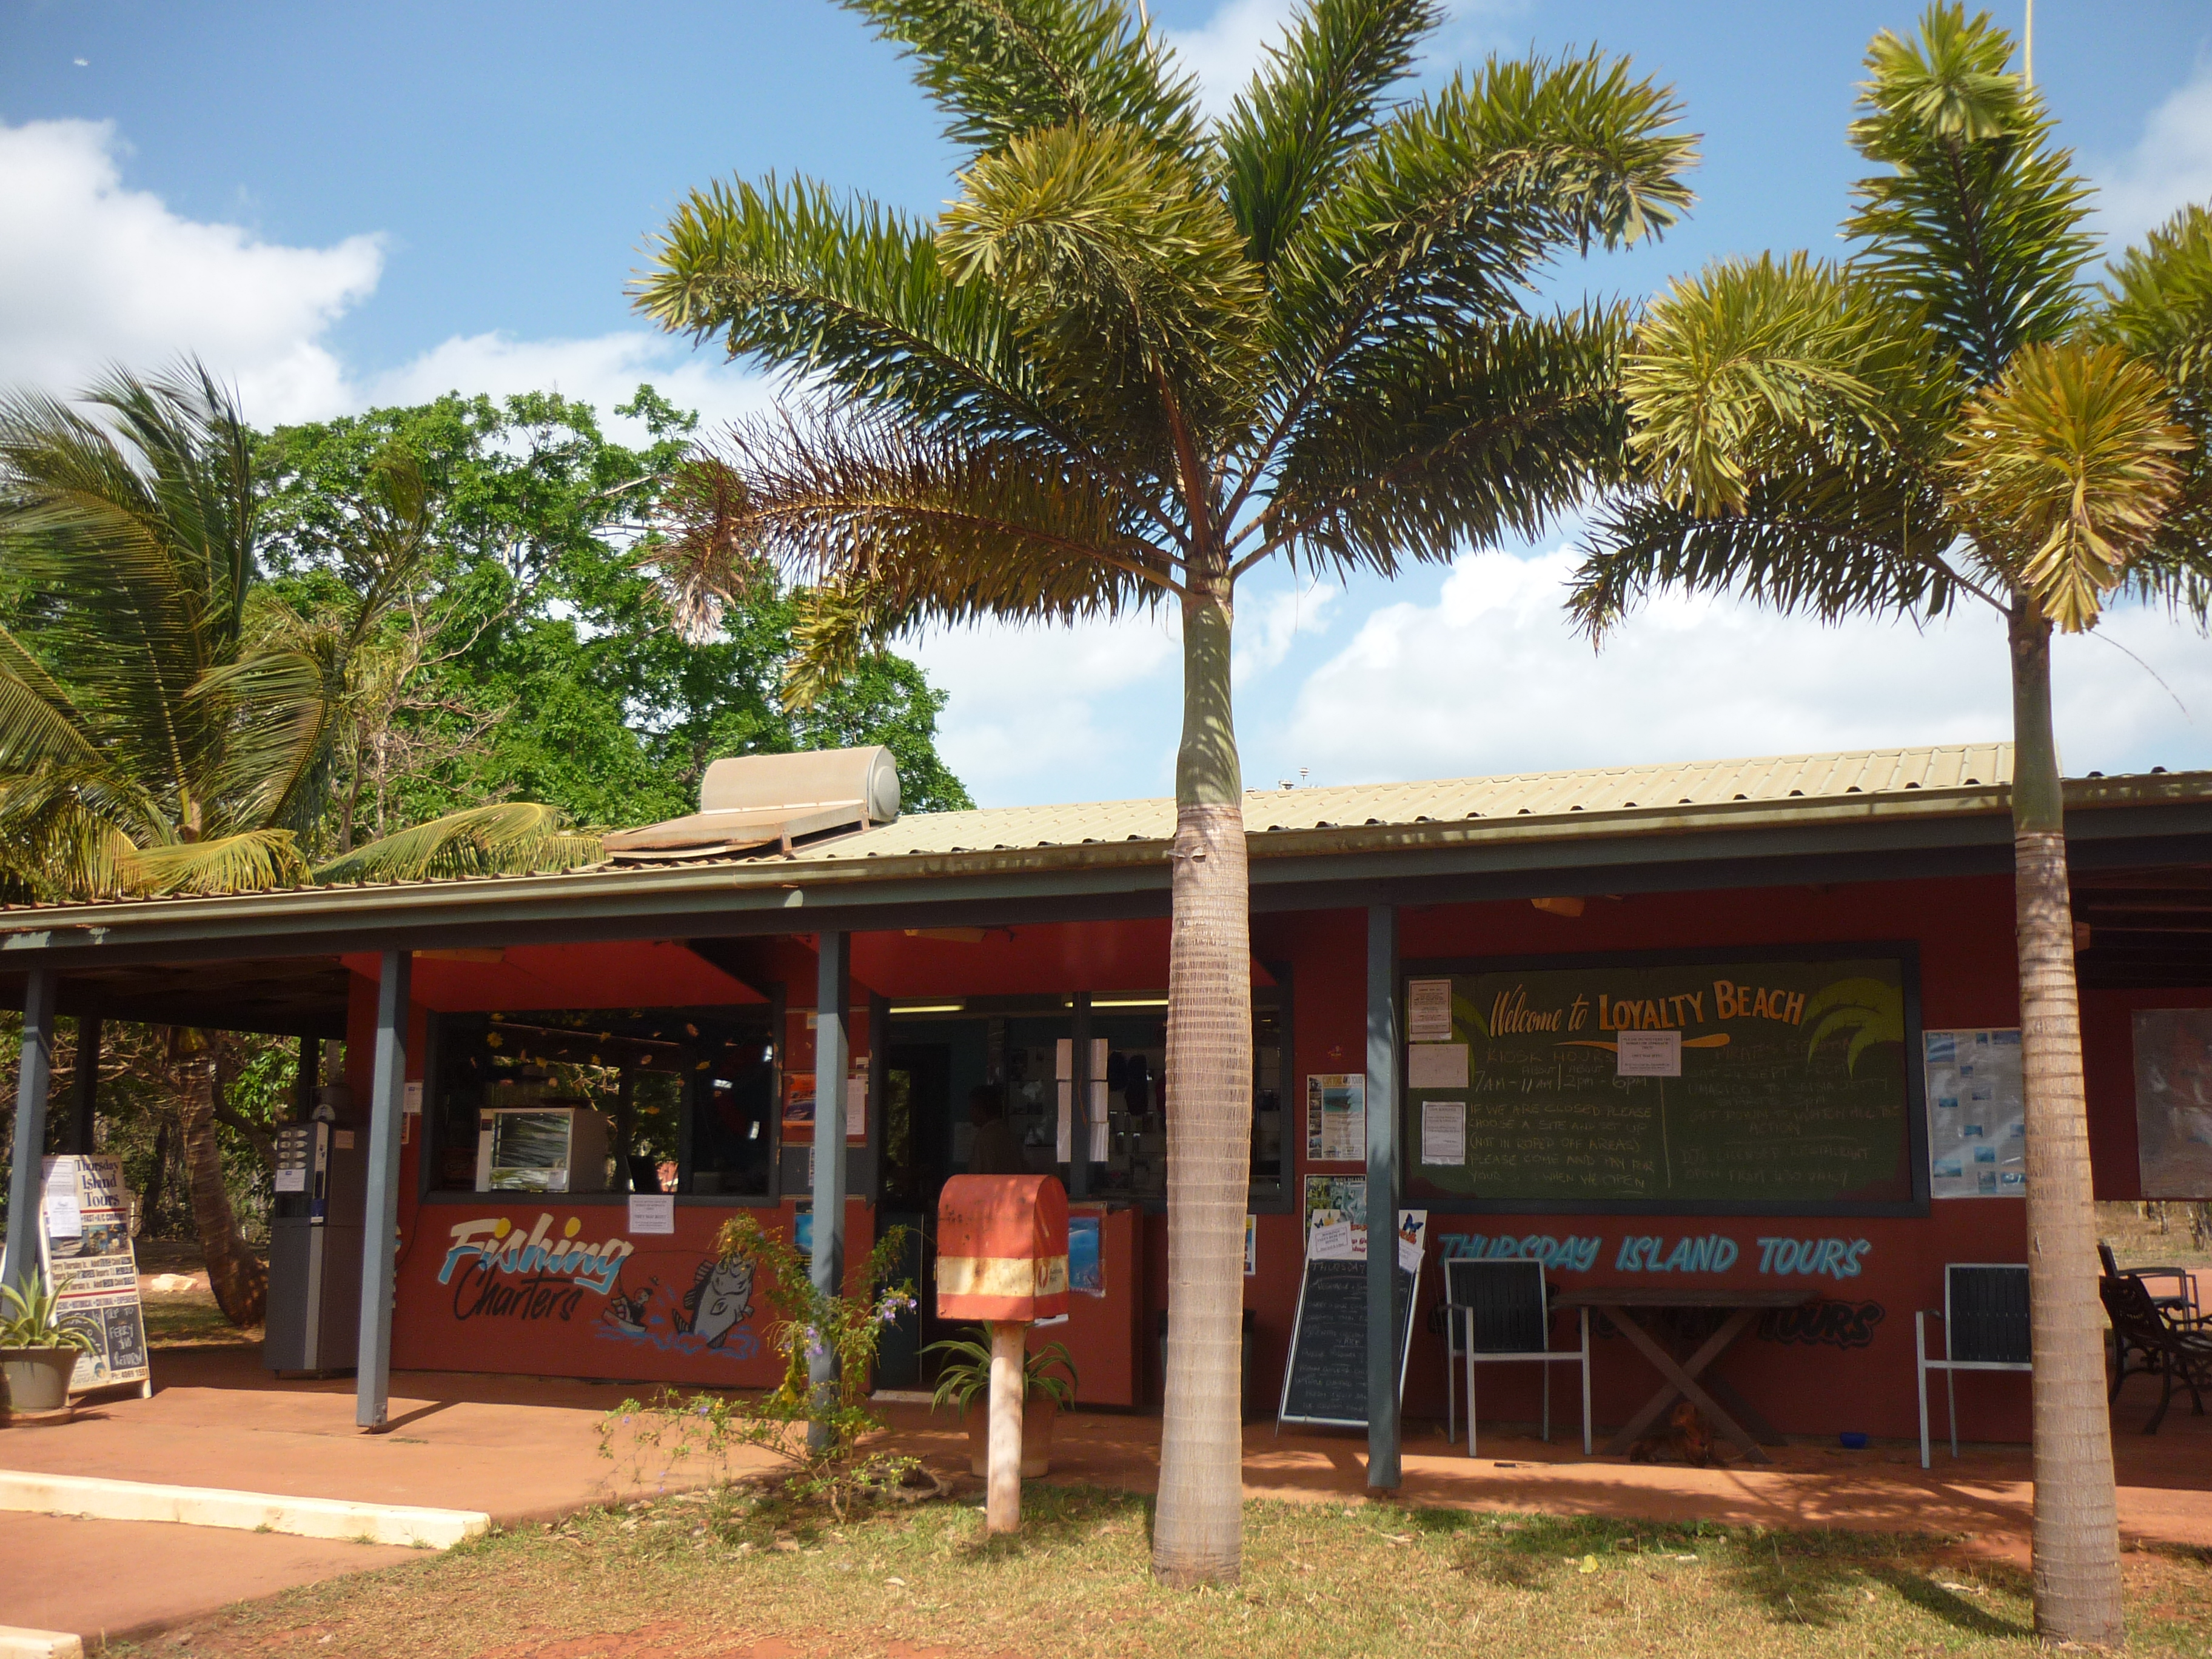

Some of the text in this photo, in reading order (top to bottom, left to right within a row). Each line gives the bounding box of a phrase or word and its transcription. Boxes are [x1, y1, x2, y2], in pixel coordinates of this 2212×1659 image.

[1490, 984, 1563, 1037] Welcome
[1567, 993, 1590, 1033] to
[1598, 990, 1704, 1032] LOYALTY
[1713, 979, 1806, 1027] BEACH
[1487, 1049, 1542, 1063] KIOSK
[1522, 1065, 1604, 1075] ABOUT ABOUT
[1470, 1103, 1653, 1118] IF WE ARE CLOSED PLEASE
[1468, 1119, 1515, 1129] CHOOSE
[1521, 1120, 1530, 1129] A
[1538, 1119, 1567, 1130] SITE
[1571, 1121, 1595, 1131] AND
[1626, 1124, 1647, 1134] UP
[1500, 1137, 1510, 1148] IN
[75, 1159, 119, 1173] Thursday
[1469, 1153, 1517, 1167] PLEASE
[1523, 1153, 1560, 1165] COME
[1567, 1154, 1596, 1165] AND
[81, 1173, 117, 1190] Island
[1468, 1170, 1503, 1184] YOUR
[1543, 1172, 1575, 1183] WHEN
[1580, 1173, 1598, 1186] WE
[1601, 1174, 1646, 1188] OPEN
[84, 1191, 120, 1207] Tours
[437, 1213, 635, 1295] Fishing
[1615, 1233, 1739, 1273] ISLAND
[1757, 1236, 1872, 1281] TOURS
[1310, 1262, 1366, 1274] THURSDAY
[452, 1259, 583, 1322] Charters
[124, 1307, 134, 1316] TO
[110, 1323, 133, 1339] FERRY
